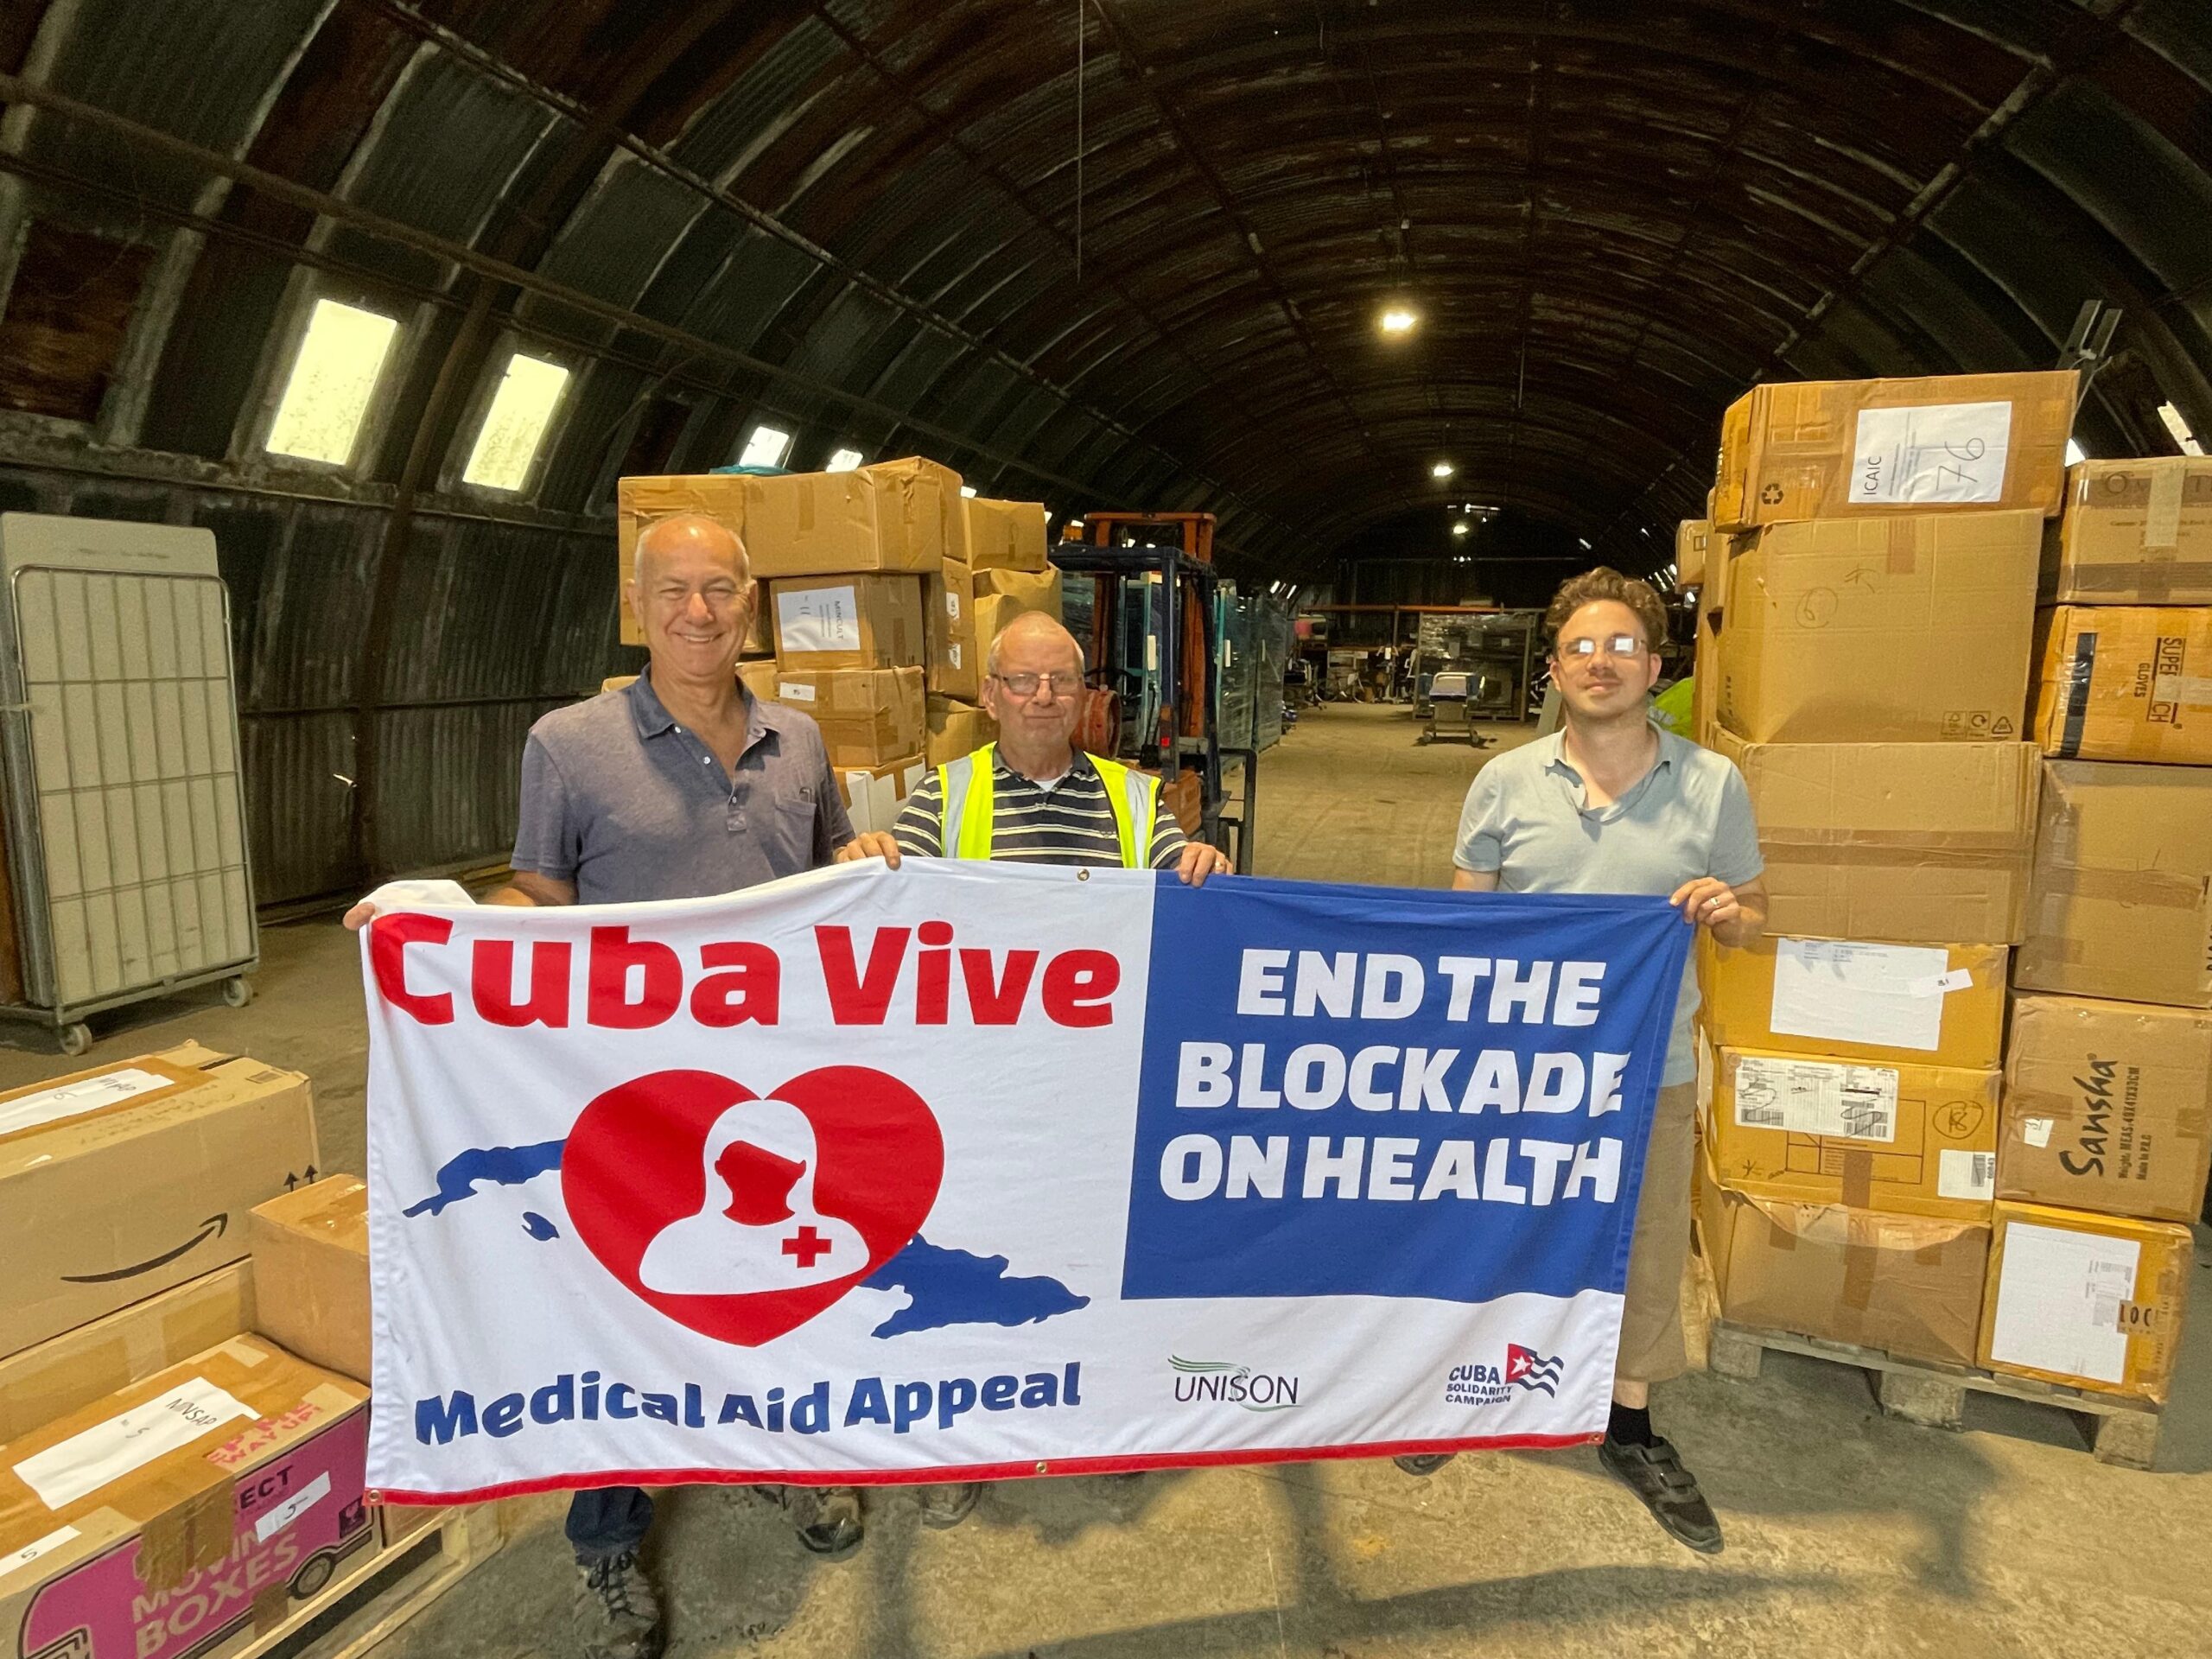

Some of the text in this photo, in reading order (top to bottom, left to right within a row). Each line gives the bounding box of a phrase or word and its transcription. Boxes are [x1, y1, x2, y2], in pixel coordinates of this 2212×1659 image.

[1863, 455, 1883, 496] ICAIC
[1936, 437, 1986, 491] 76
[2133, 662, 2152, 698] GLOVES
[370, 912, 1121, 1029] Cuba Vive
[1236, 949, 1607, 1027] END THE
[1175, 1042, 1631, 1117] BLOCKADE
[2058, 1060, 2119, 1178] Sansha
[1160, 1134, 1624, 1206] ON HEALTH
[416, 1363, 1080, 1445] Medical Aid Appeal
[1175, 1374, 1299, 1404] UNISON
[1445, 1394, 1511, 1407] CAMPAIGN
[1446, 1383, 1513, 1396] SOLIDARITY
[1448, 1364, 1501, 1385] CUBA
[135, 1532, 300, 1659] BOXES
